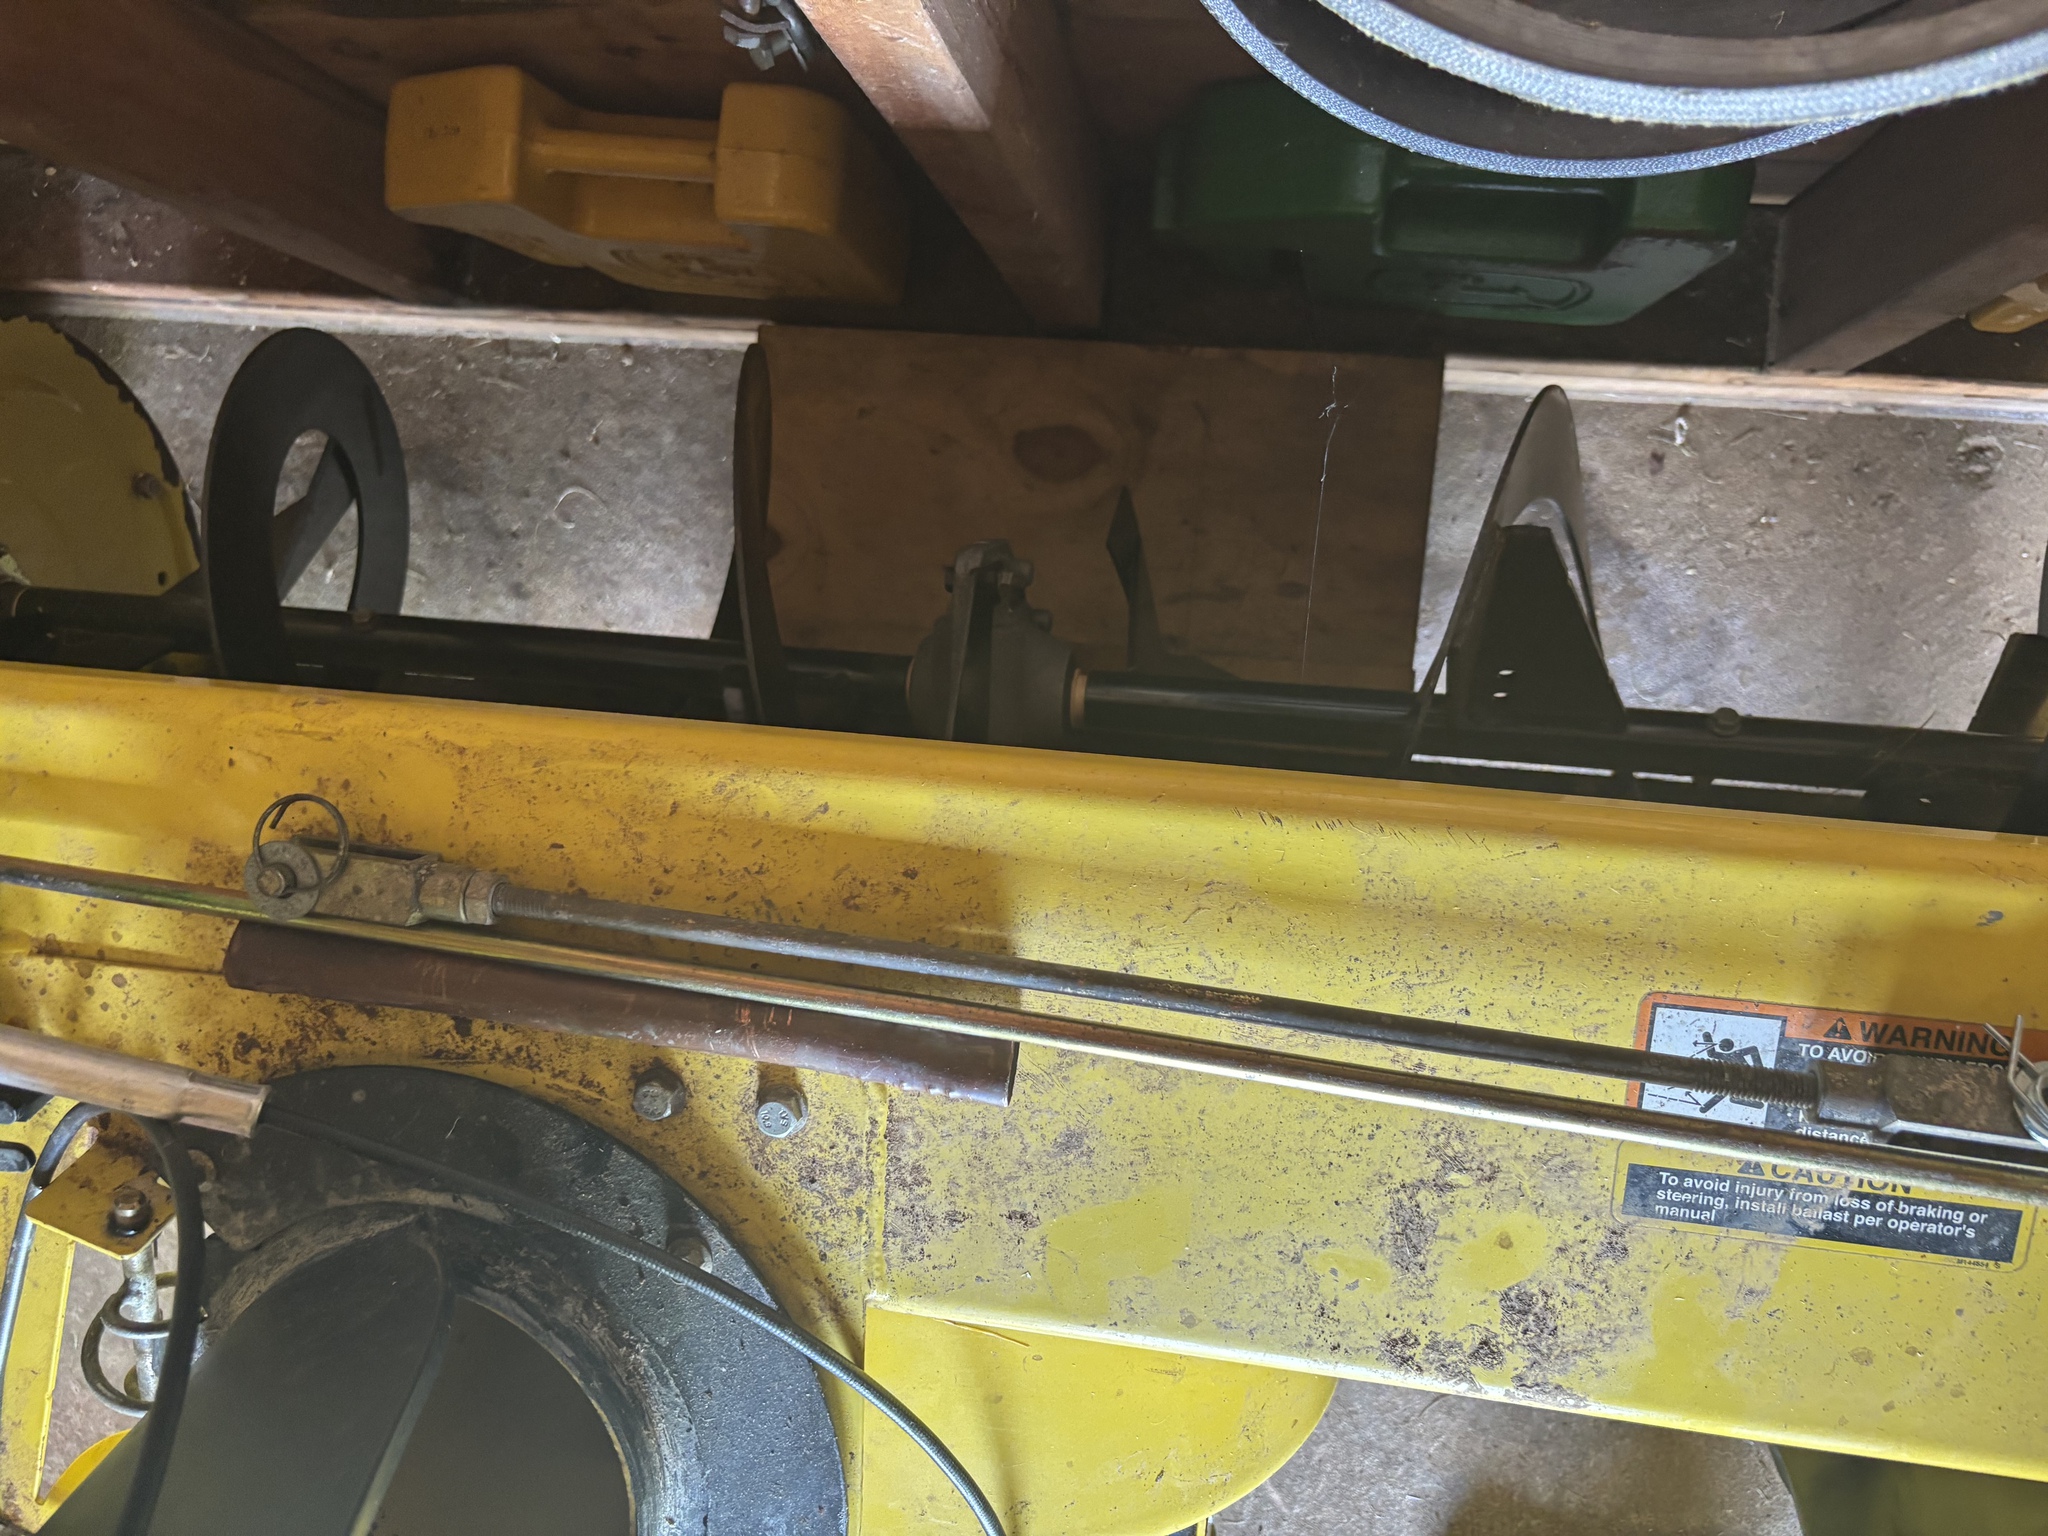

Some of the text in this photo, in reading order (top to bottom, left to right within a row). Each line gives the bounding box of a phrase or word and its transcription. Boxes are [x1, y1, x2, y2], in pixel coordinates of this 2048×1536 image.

[1798, 1043, 1824, 1059] TO
[1860, 1020, 2013, 1057] WARNING
[1655, 1204, 1716, 1222] manual
[1656, 1189, 1729, 1210] steering,
[1734, 1197, 1787, 1215] install
[1853, 1213, 1884, 1228] per
[1887, 1217, 1976, 1238] operator's
[1659, 1171, 1989, 1225] To avoid injury from loss of braking or
